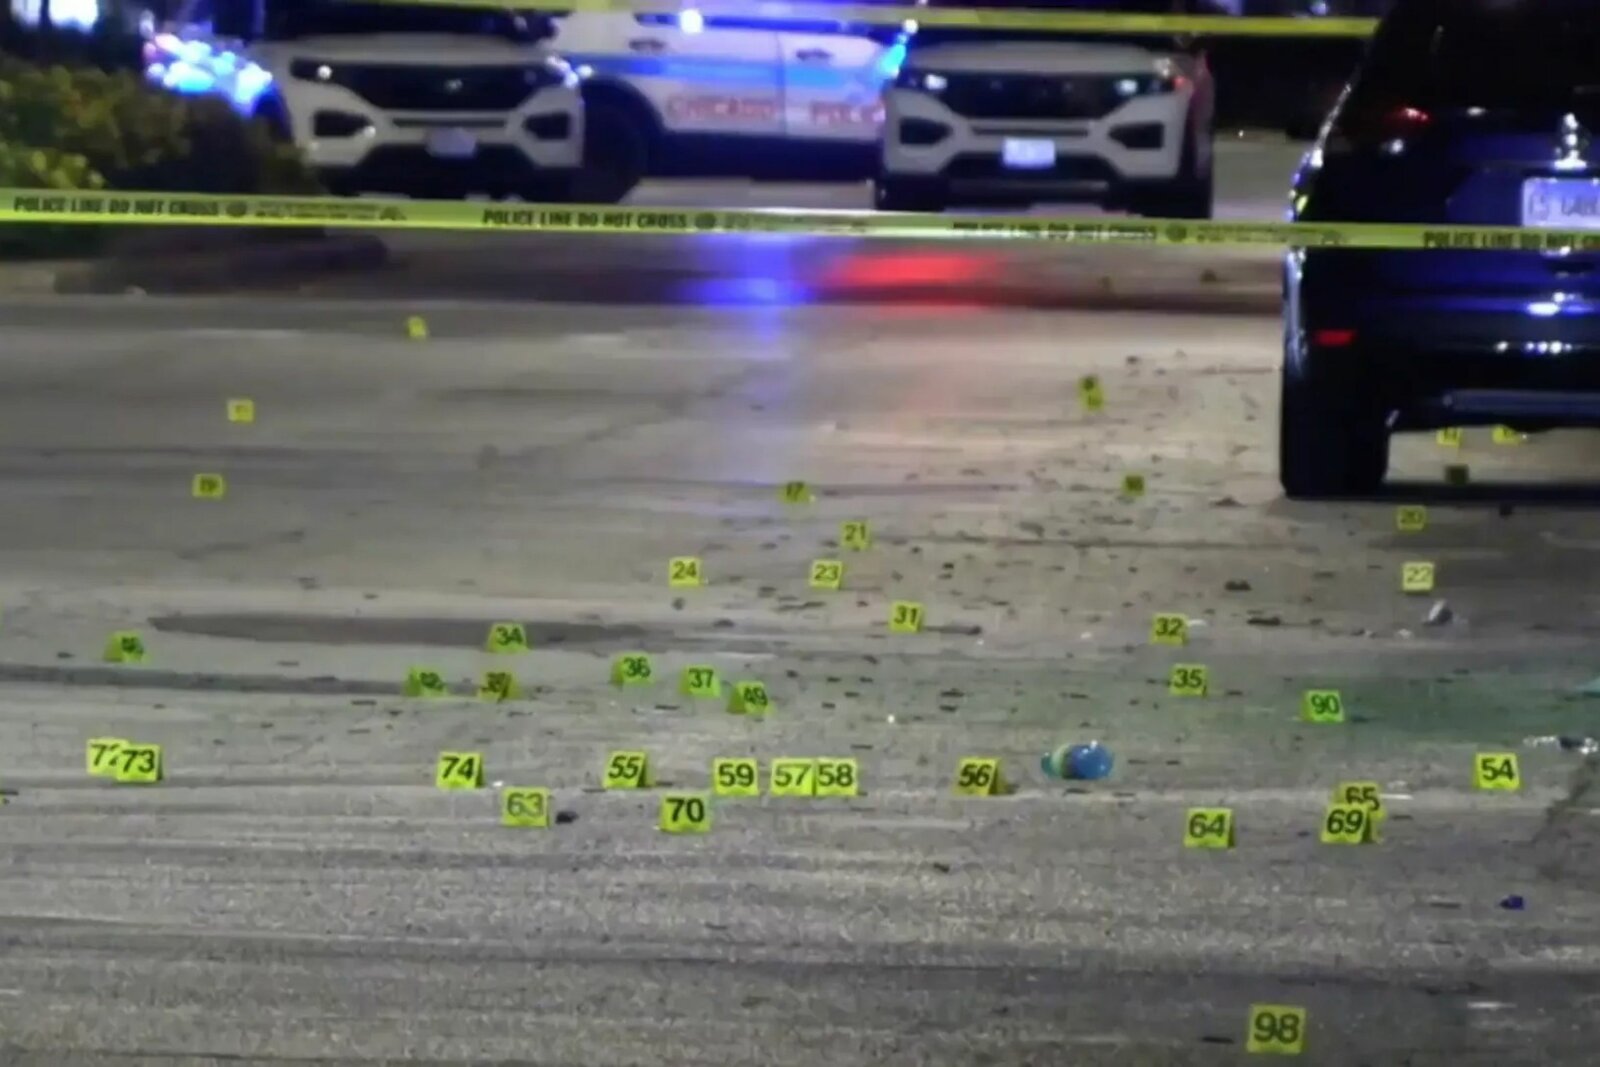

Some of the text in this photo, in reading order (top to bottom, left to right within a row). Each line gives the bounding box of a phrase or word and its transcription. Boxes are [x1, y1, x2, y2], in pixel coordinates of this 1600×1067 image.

[14, 196, 219, 216] POLICE LINE DO NOT CROSS
[483, 209, 687, 228] POLICE LINE DO NOT CROSS
[1424, 231, 1475, 248] POLICE
[1482, 232, 1514, 248] LINE
[1547, 233, 1575, 249] NOT
[844, 523, 866, 542] 21
[671, 562, 698, 581] 24
[814, 564, 840, 582] 23
[1406, 565, 1432, 583] 22
[894, 604, 918, 625] 31
[496, 626, 523, 646] 34
[1155, 617, 1182, 637] 32
[623, 656, 651, 678] 36
[688, 667, 714, 688] 37
[1173, 668, 1203, 688] 35
[1310, 694, 1340, 715] 90
[122, 748, 155, 774] 73
[441, 755, 475, 780] 74
[607, 755, 641, 779] 55
[1481, 757, 1514, 782] 54
[718, 762, 755, 787] 59
[774, 763, 811, 787] 57
[817, 763, 854, 787] 58
[958, 763, 992, 787] 56
[506, 791, 544, 817] 63
[1345, 785, 1380, 811] 65
[665, 797, 705, 823] 70
[1326, 808, 1364, 835] 69
[1189, 813, 1225, 839] 64
[1253, 1011, 1300, 1045] 98
